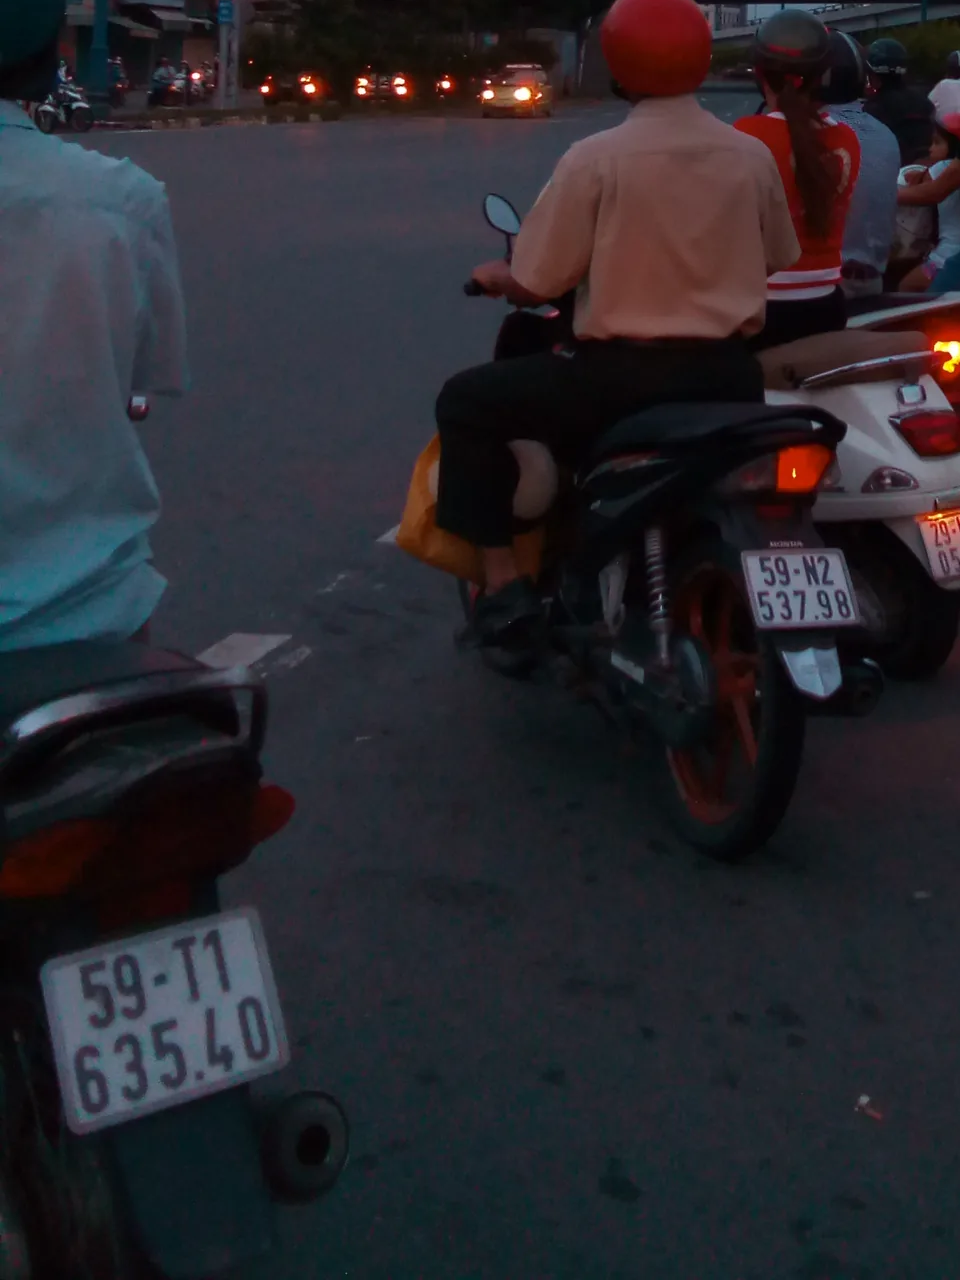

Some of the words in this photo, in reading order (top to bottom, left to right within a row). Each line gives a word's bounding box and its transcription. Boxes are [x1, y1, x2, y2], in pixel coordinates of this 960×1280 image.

[758, 555, 835, 587] 59-N2
[756, 588, 852, 621] 537.98
[78, 929, 231, 1029] 59-T1
[73, 995, 272, 1115] 635.40
